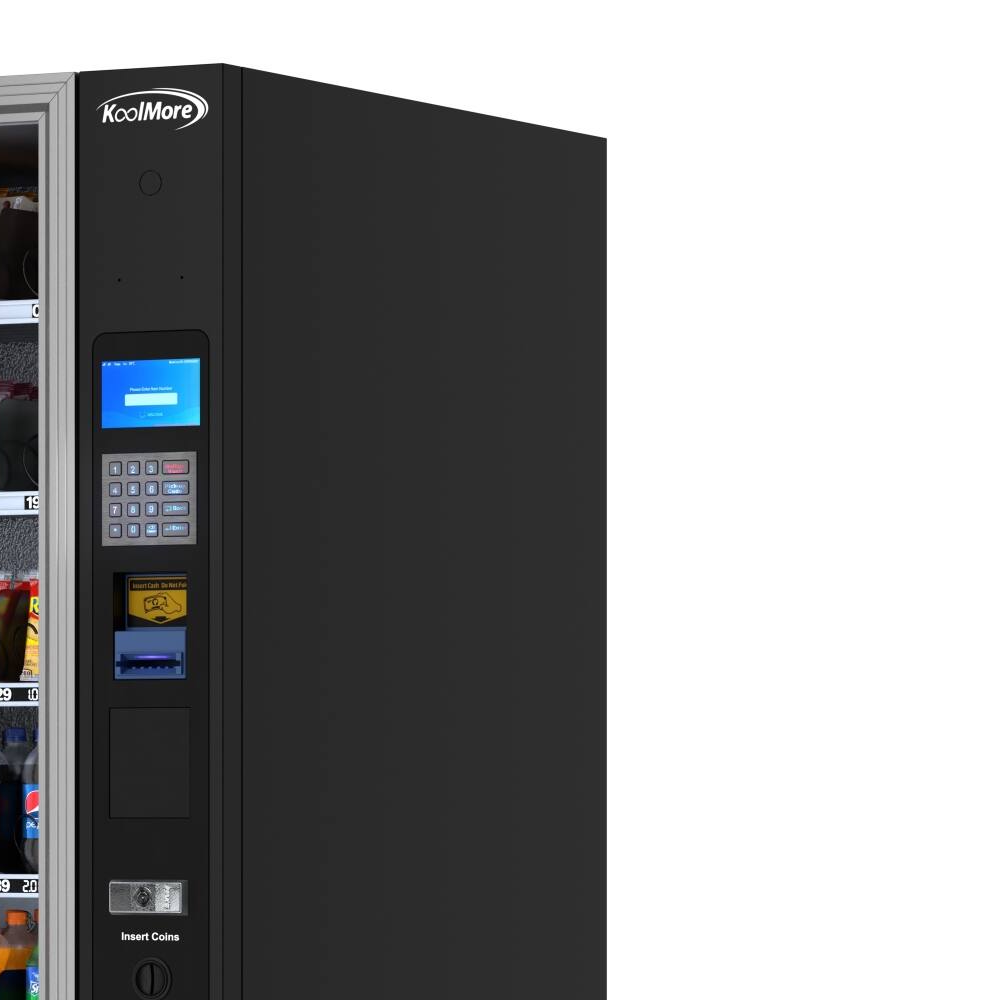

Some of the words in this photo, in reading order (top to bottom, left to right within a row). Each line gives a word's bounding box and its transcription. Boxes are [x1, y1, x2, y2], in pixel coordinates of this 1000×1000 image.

[102, 102, 193, 123] KoolMore
[26, 497, 38, 509] 19
[28, 689, 38, 701] 1.0
[22, 880, 38, 892] 2.0
[121, 932, 149, 941] Insert
[152, 932, 180, 942] Coins
